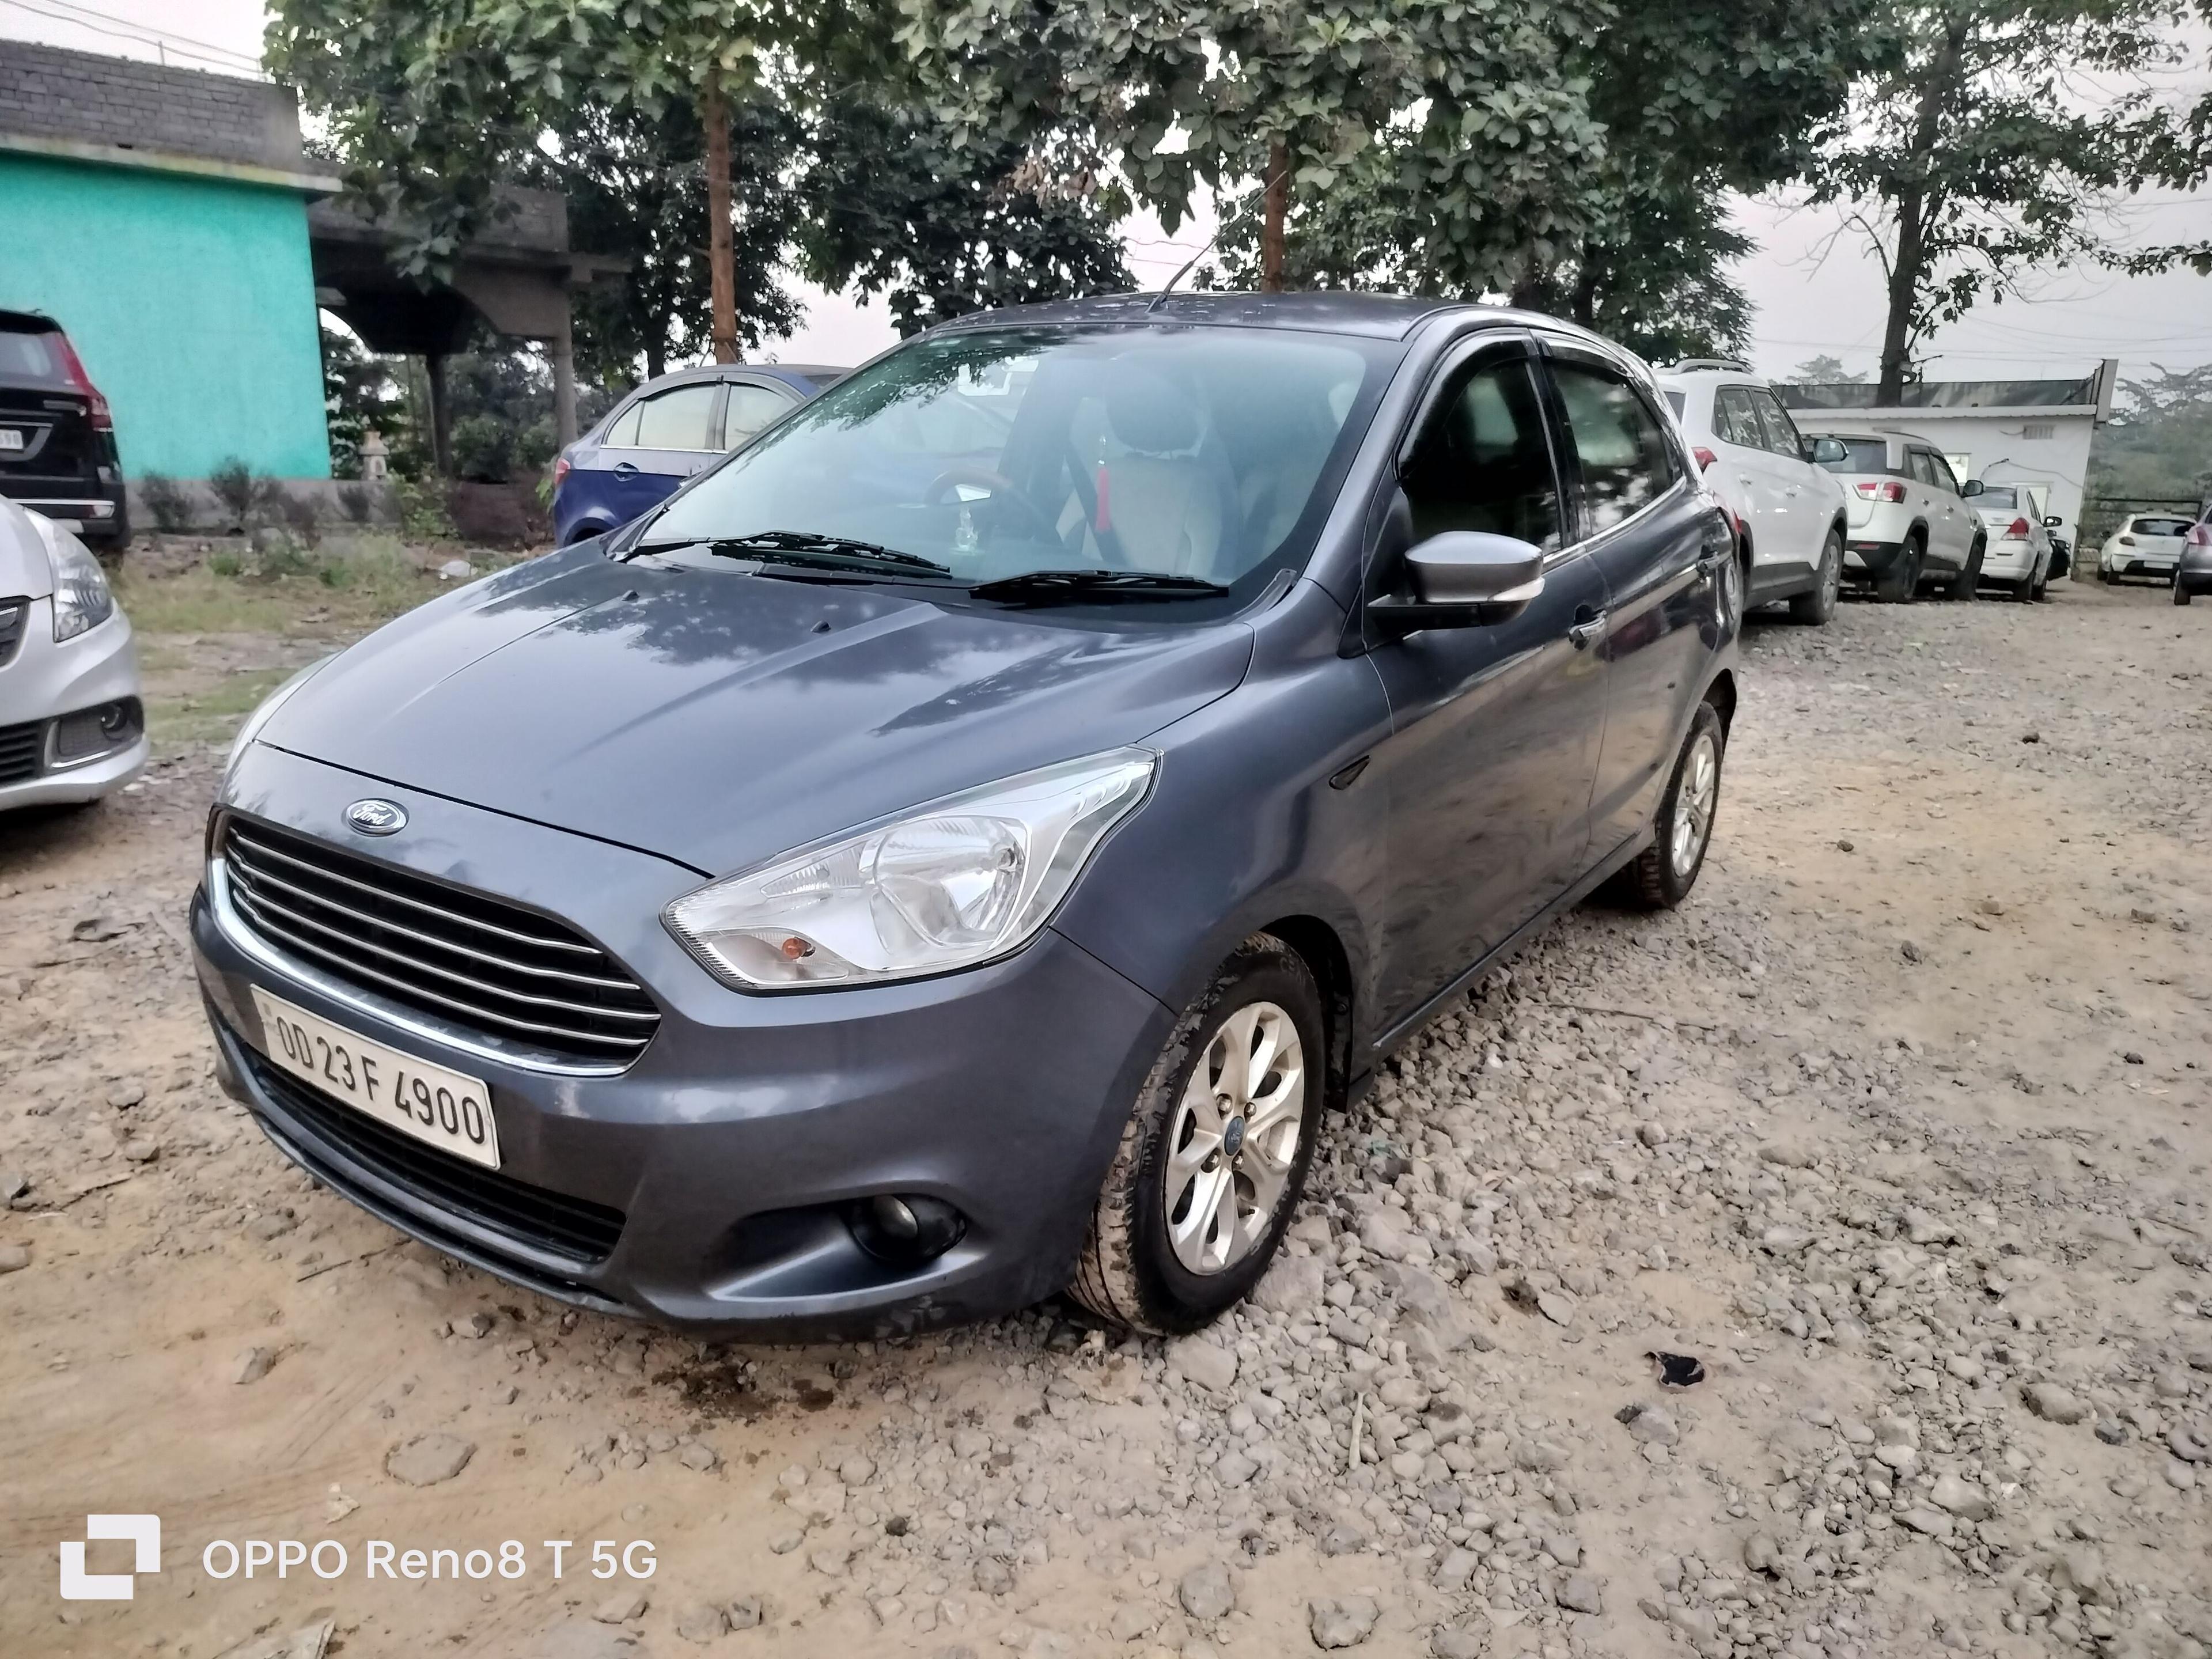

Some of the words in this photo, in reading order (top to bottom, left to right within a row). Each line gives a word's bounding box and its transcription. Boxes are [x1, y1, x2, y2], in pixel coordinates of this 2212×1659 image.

[352, 803, 392, 825] Ford
[316, 1036, 356, 1092] 23
[361, 1055, 380, 1101] F
[395, 1071, 485, 1145] 4900
